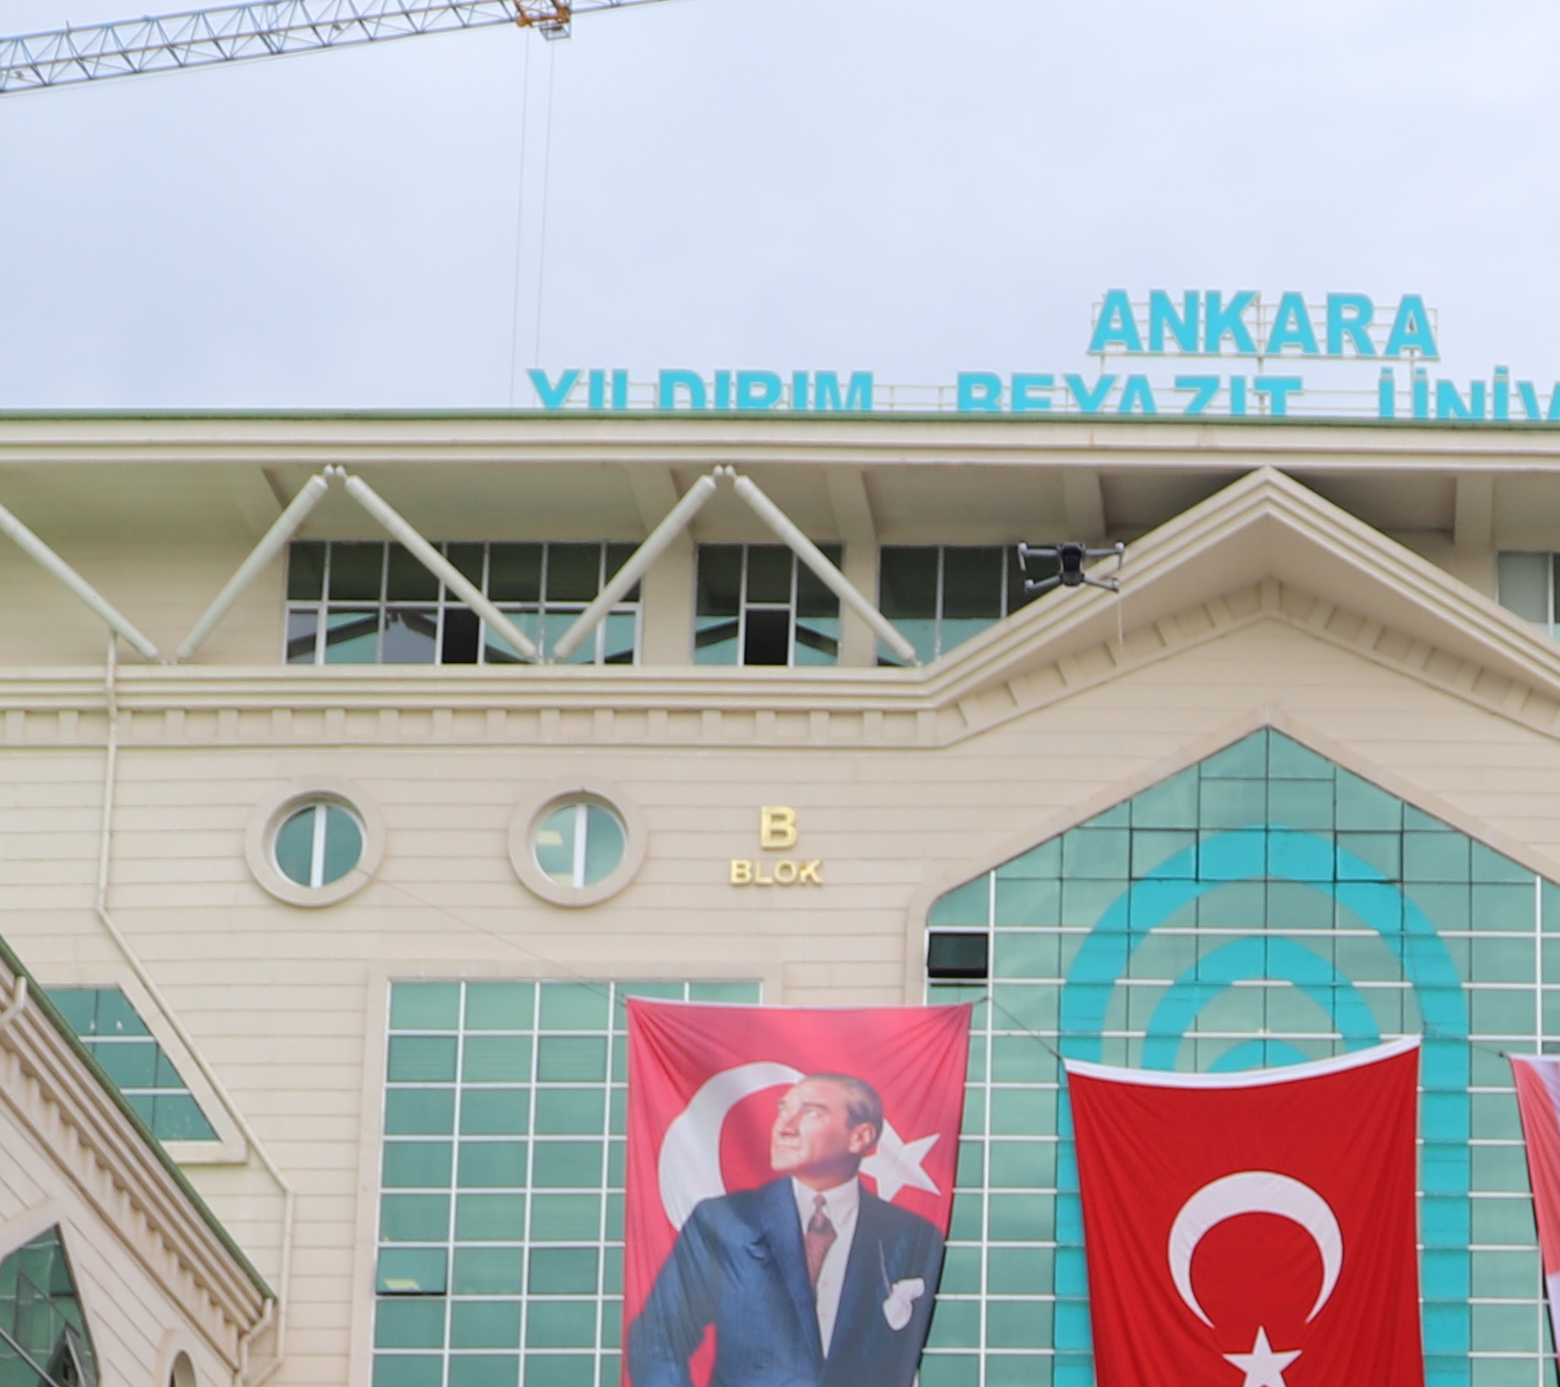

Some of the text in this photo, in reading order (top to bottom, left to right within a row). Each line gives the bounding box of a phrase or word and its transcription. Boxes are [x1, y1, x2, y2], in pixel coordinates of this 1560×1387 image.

[1091, 290, 1437, 357] ANKARA
[528, 369, 874, 411] YILDIRIM
[957, 373, 1303, 417] BEYAZIT
[760, 805, 799, 850] B
[730, 859, 823, 887] BLOK
